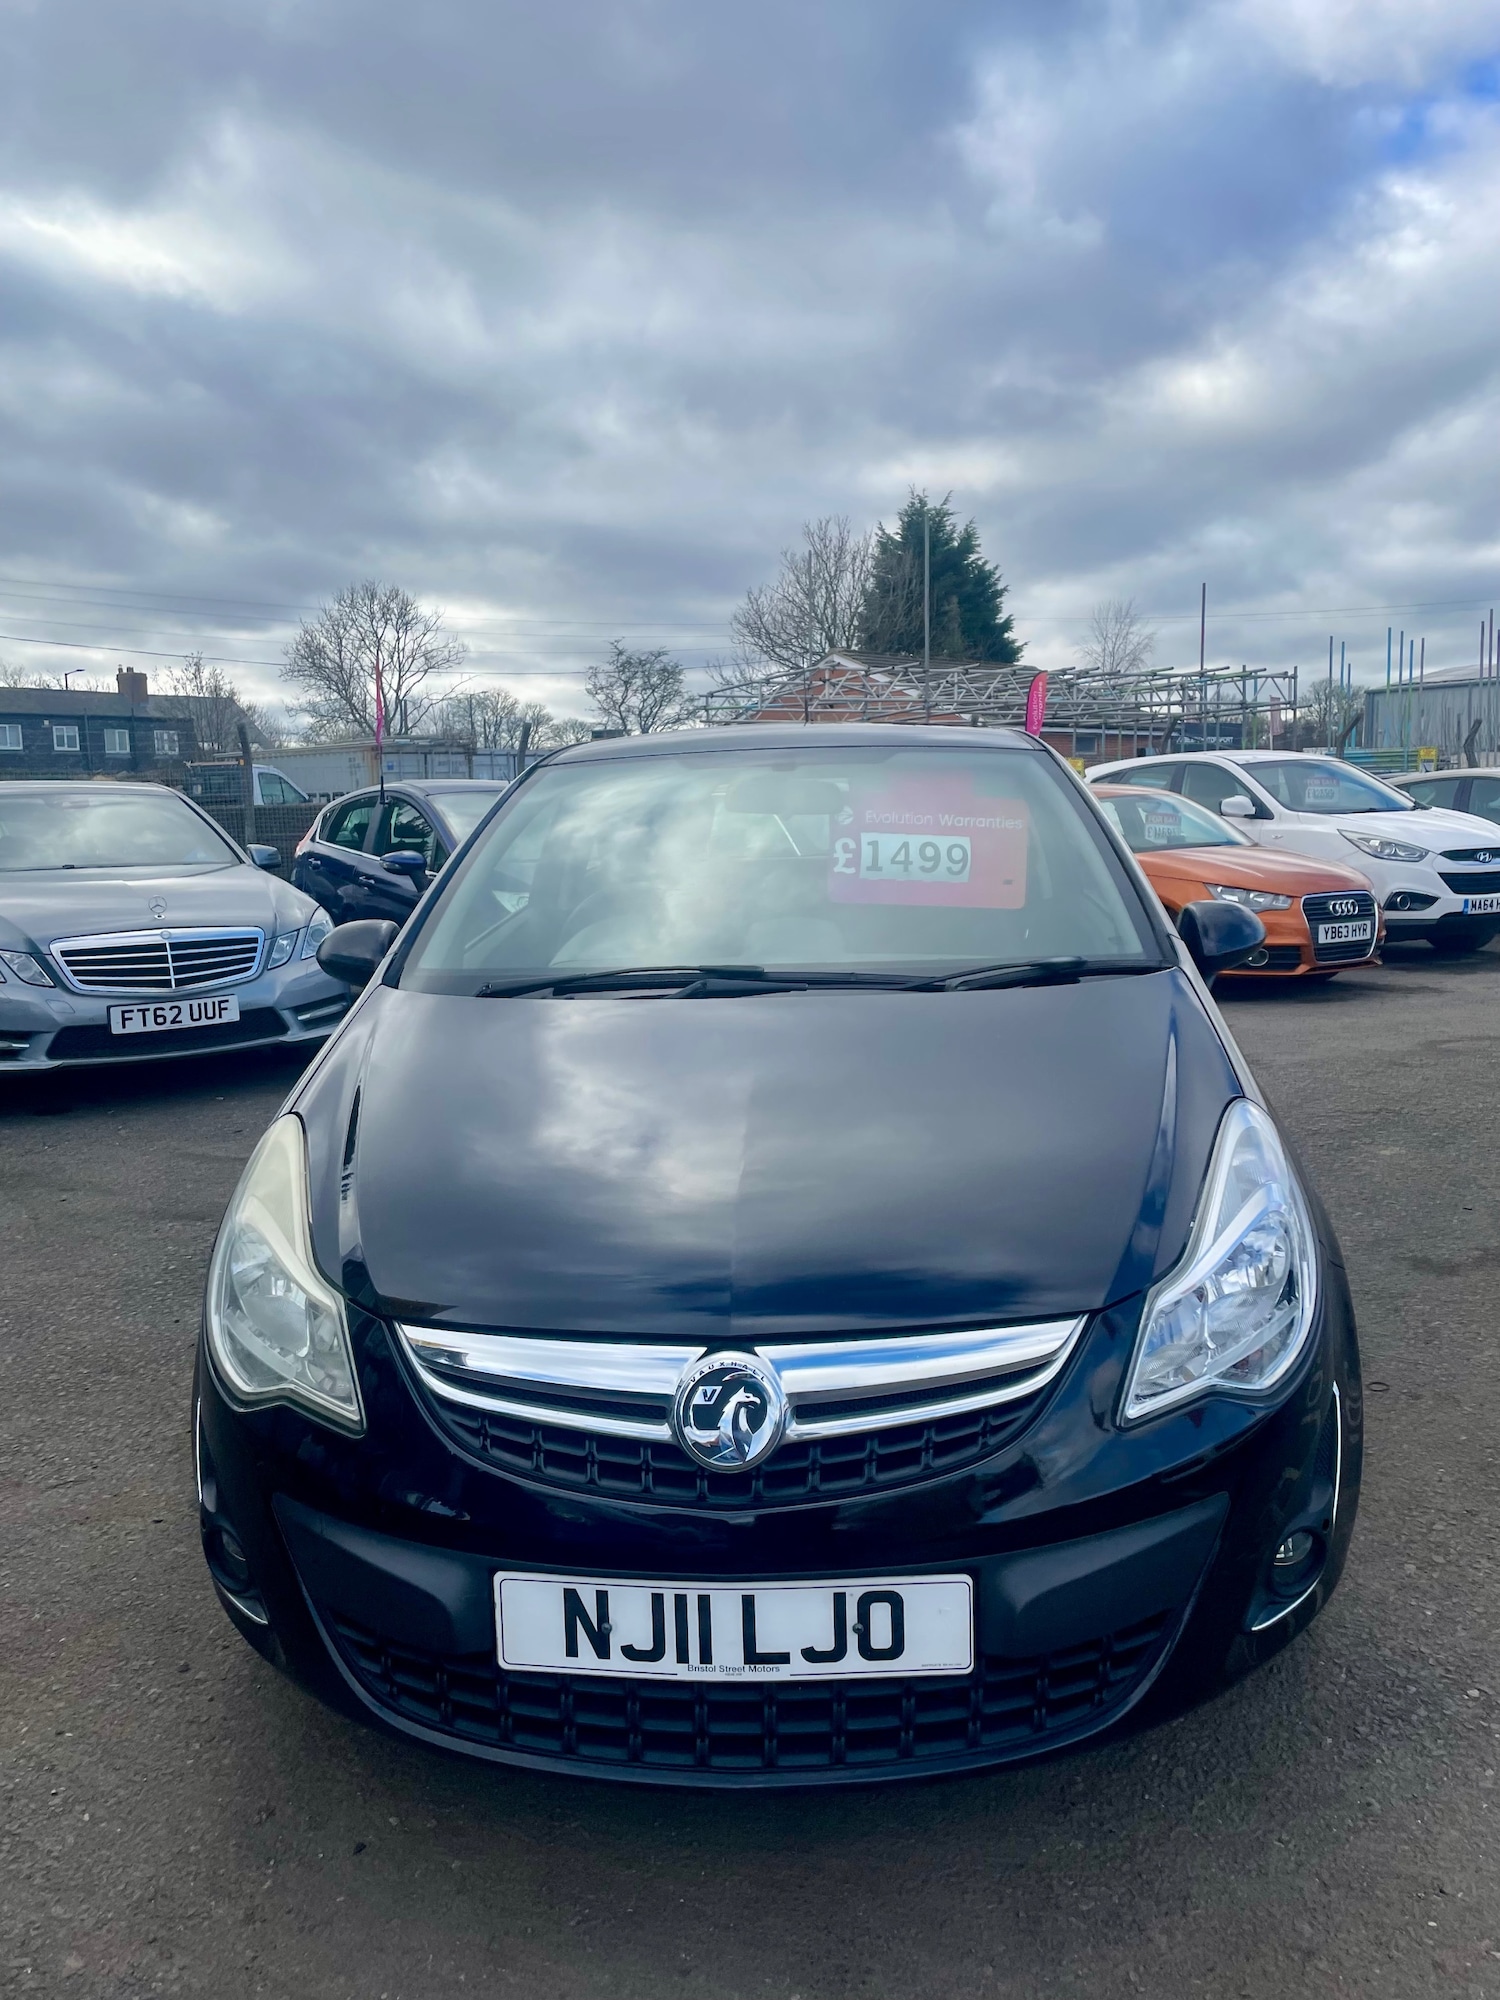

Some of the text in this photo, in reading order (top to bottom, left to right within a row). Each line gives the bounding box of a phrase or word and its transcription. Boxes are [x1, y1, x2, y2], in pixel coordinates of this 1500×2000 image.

[865, 810, 1024, 830] Evolution Warranties
[1470, 899, 1494, 911] MA64
[1323, 923, 1368, 940] YB63 HYR
[121, 1000, 229, 1029] FT62 UUF
[690, 1361, 766, 1383] VAUXHALL
[741, 1590, 905, 1665] LJO
[687, 1664, 781, 1673] Bristol Street Motors
